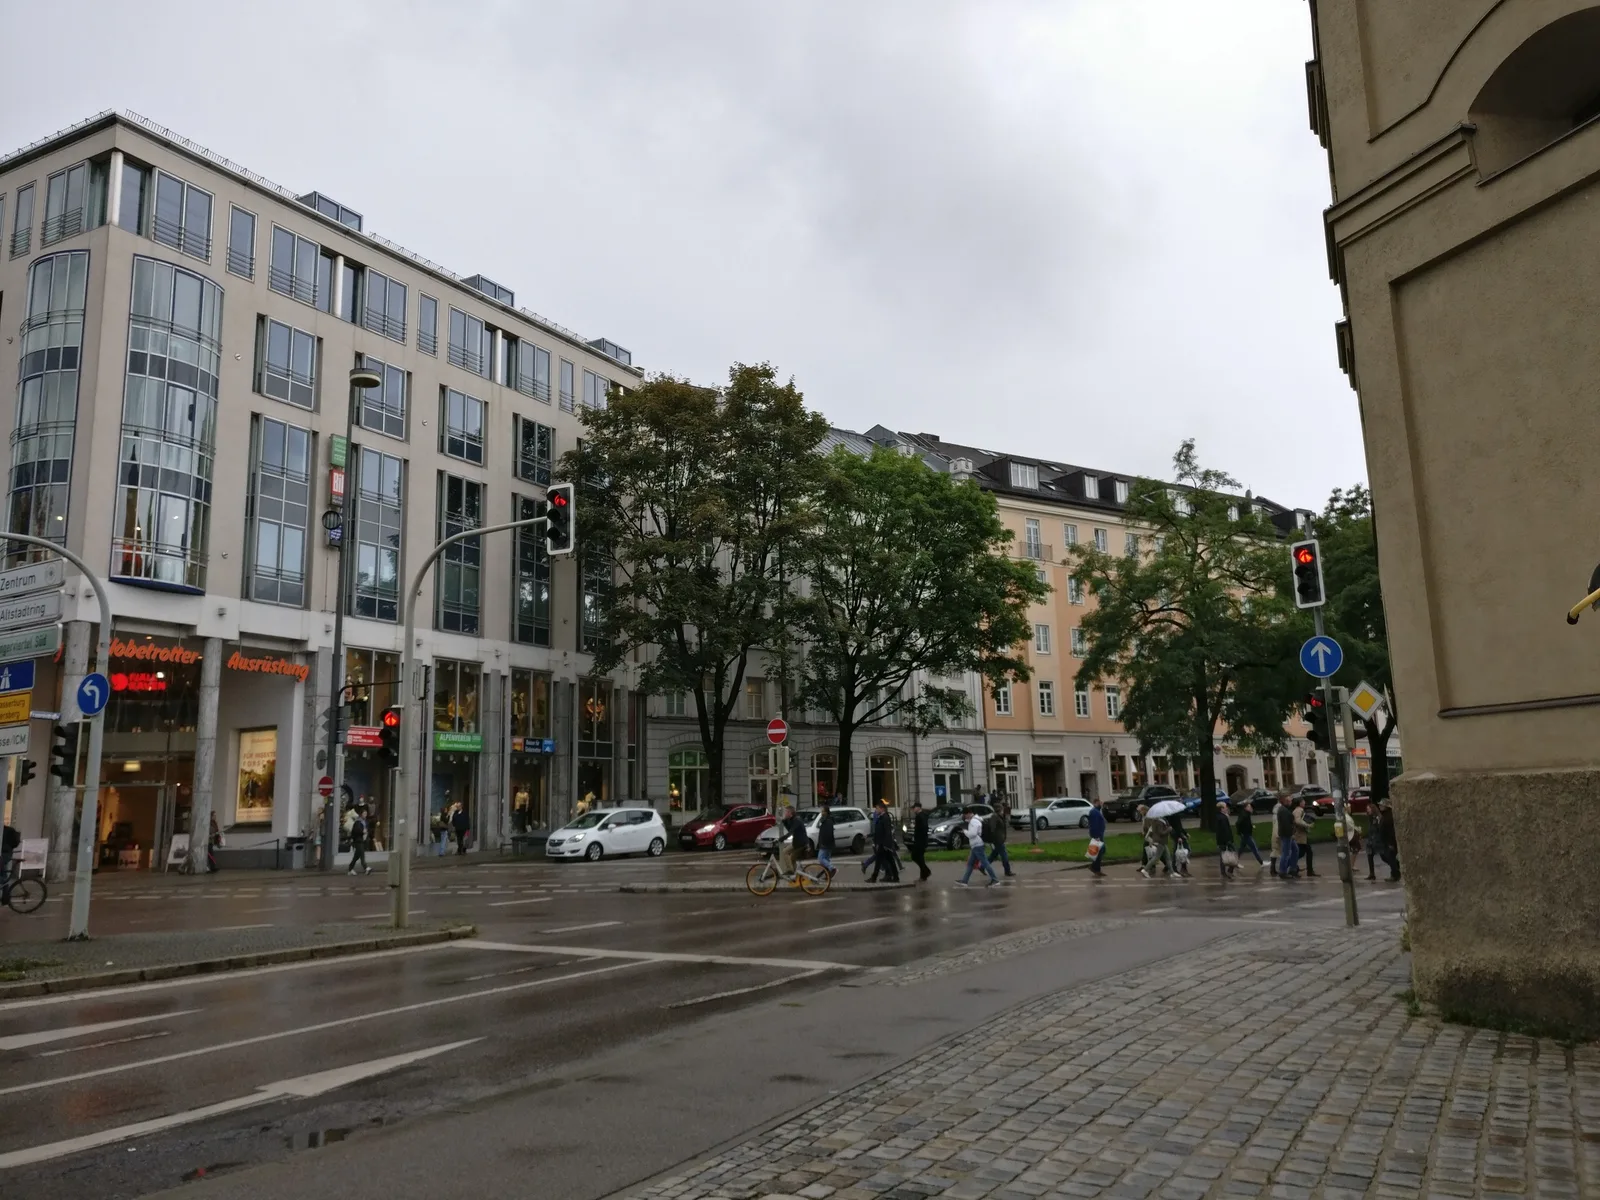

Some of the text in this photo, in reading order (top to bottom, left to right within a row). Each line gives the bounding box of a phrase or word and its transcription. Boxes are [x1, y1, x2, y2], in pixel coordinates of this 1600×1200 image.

[0, 574, 36, 591] Zentrum
[0, 604, 46, 621] Altstadtring
[97, 637, 199, 664] lobetrotter
[227, 651, 310, 683] Ausrüstung
[0, 699, 26, 709] asserburg
[0, 711, 20, 720] ersberg
[0, 734, 27, 748] sse/ICM
